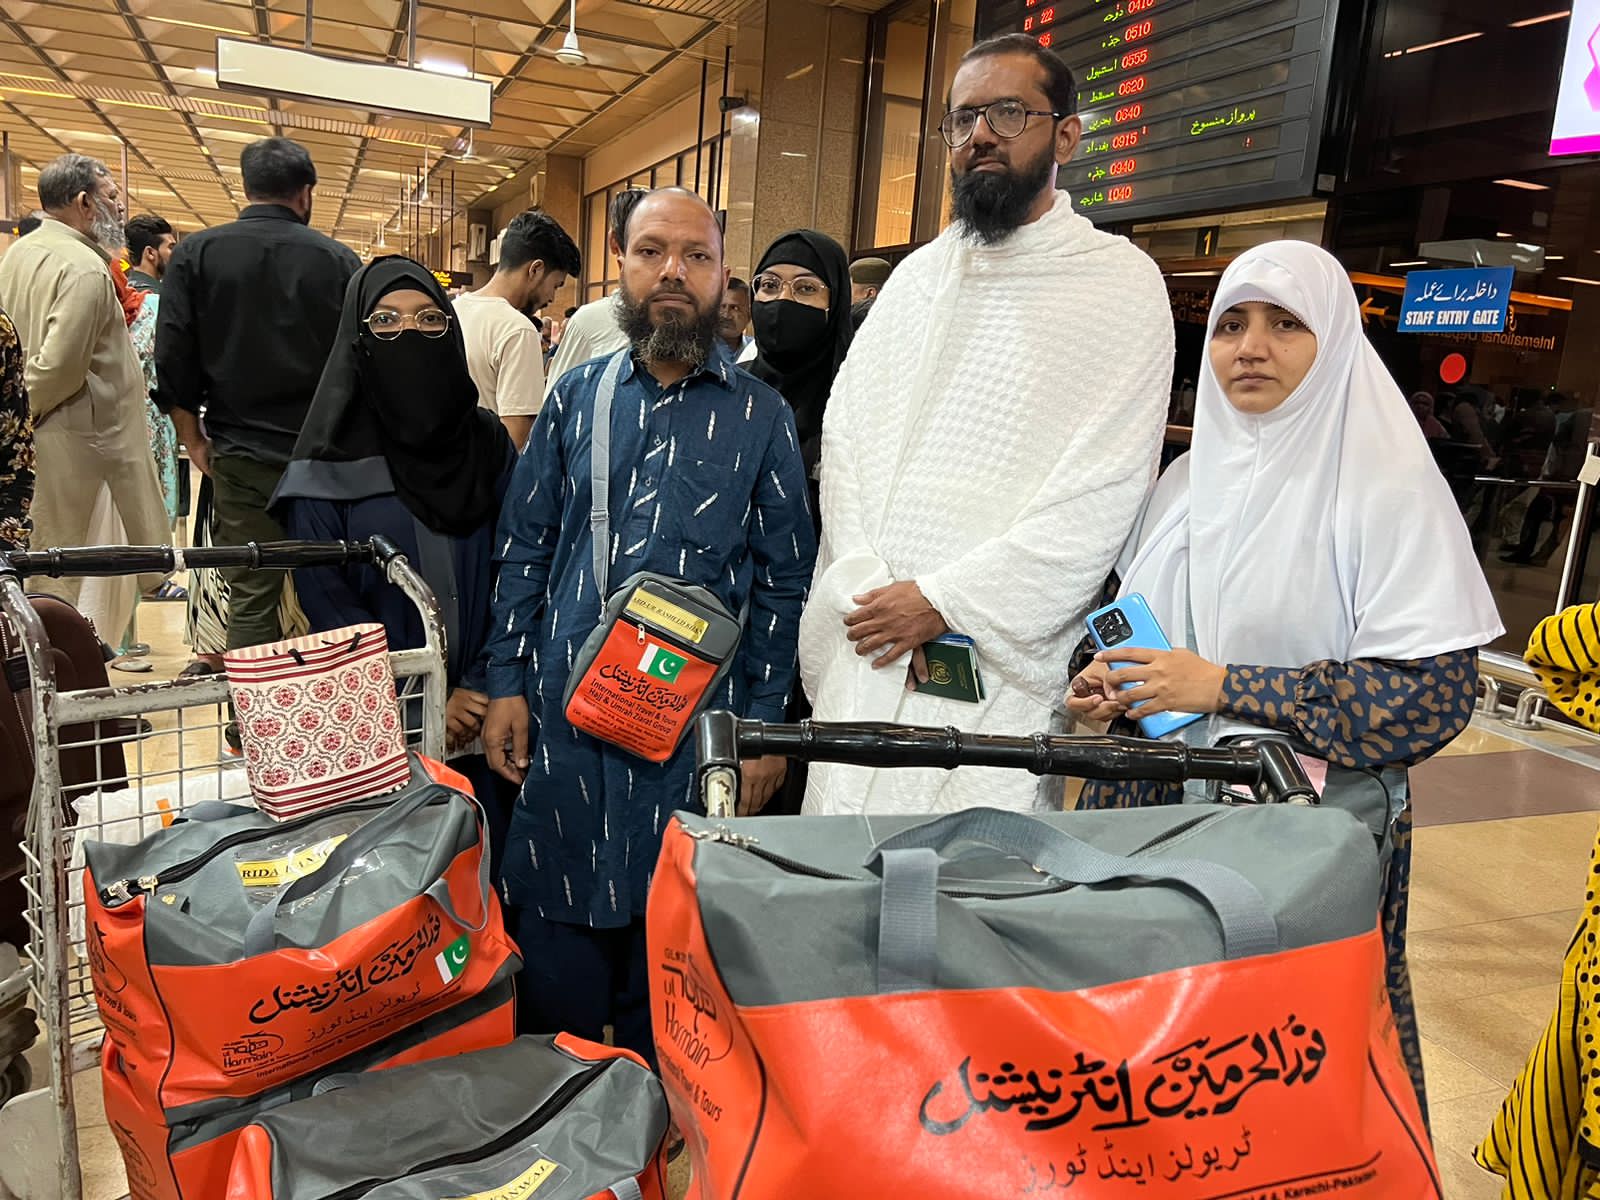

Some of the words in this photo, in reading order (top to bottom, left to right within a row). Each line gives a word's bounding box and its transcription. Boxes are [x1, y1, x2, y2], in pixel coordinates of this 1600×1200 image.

[1040, 8, 1054, 24] 222
[1124, 21, 1152, 41] 0510
[1121, 49, 1149, 69] 0555
[1112, 132, 1138, 150] 0915
[1109, 159, 1136, 177] 0940
[1107, 186, 1132, 202] 1040
[1203, 230, 1212, 256] 1
[1405, 310, 1434, 326] STAFF
[1436, 309, 1471, 326] ENTRY
[1472, 309, 1500, 325] GATE
[588, 688, 602, 702] Hajj
[603, 697, 610, 705] &
[610, 700, 634, 719] Umrah
[653, 720, 672, 735] Group
[591, 678, 635, 708] International
[635, 703, 655, 718] Travel
[654, 713, 661, 721] &
[661, 713, 677, 727] Tours
[242, 869, 279, 878] RIDA
[664, 1000, 711, 1070] Harmain
[223, 1049, 273, 1068] Harmain
[700, 1089, 723, 1122] Tours
[1096, 1136, 1155, 1183] اینڈ
[1162, 1125, 1252, 1183] ٹریولز
[1021, 1143, 1088, 1194] ٹورز
